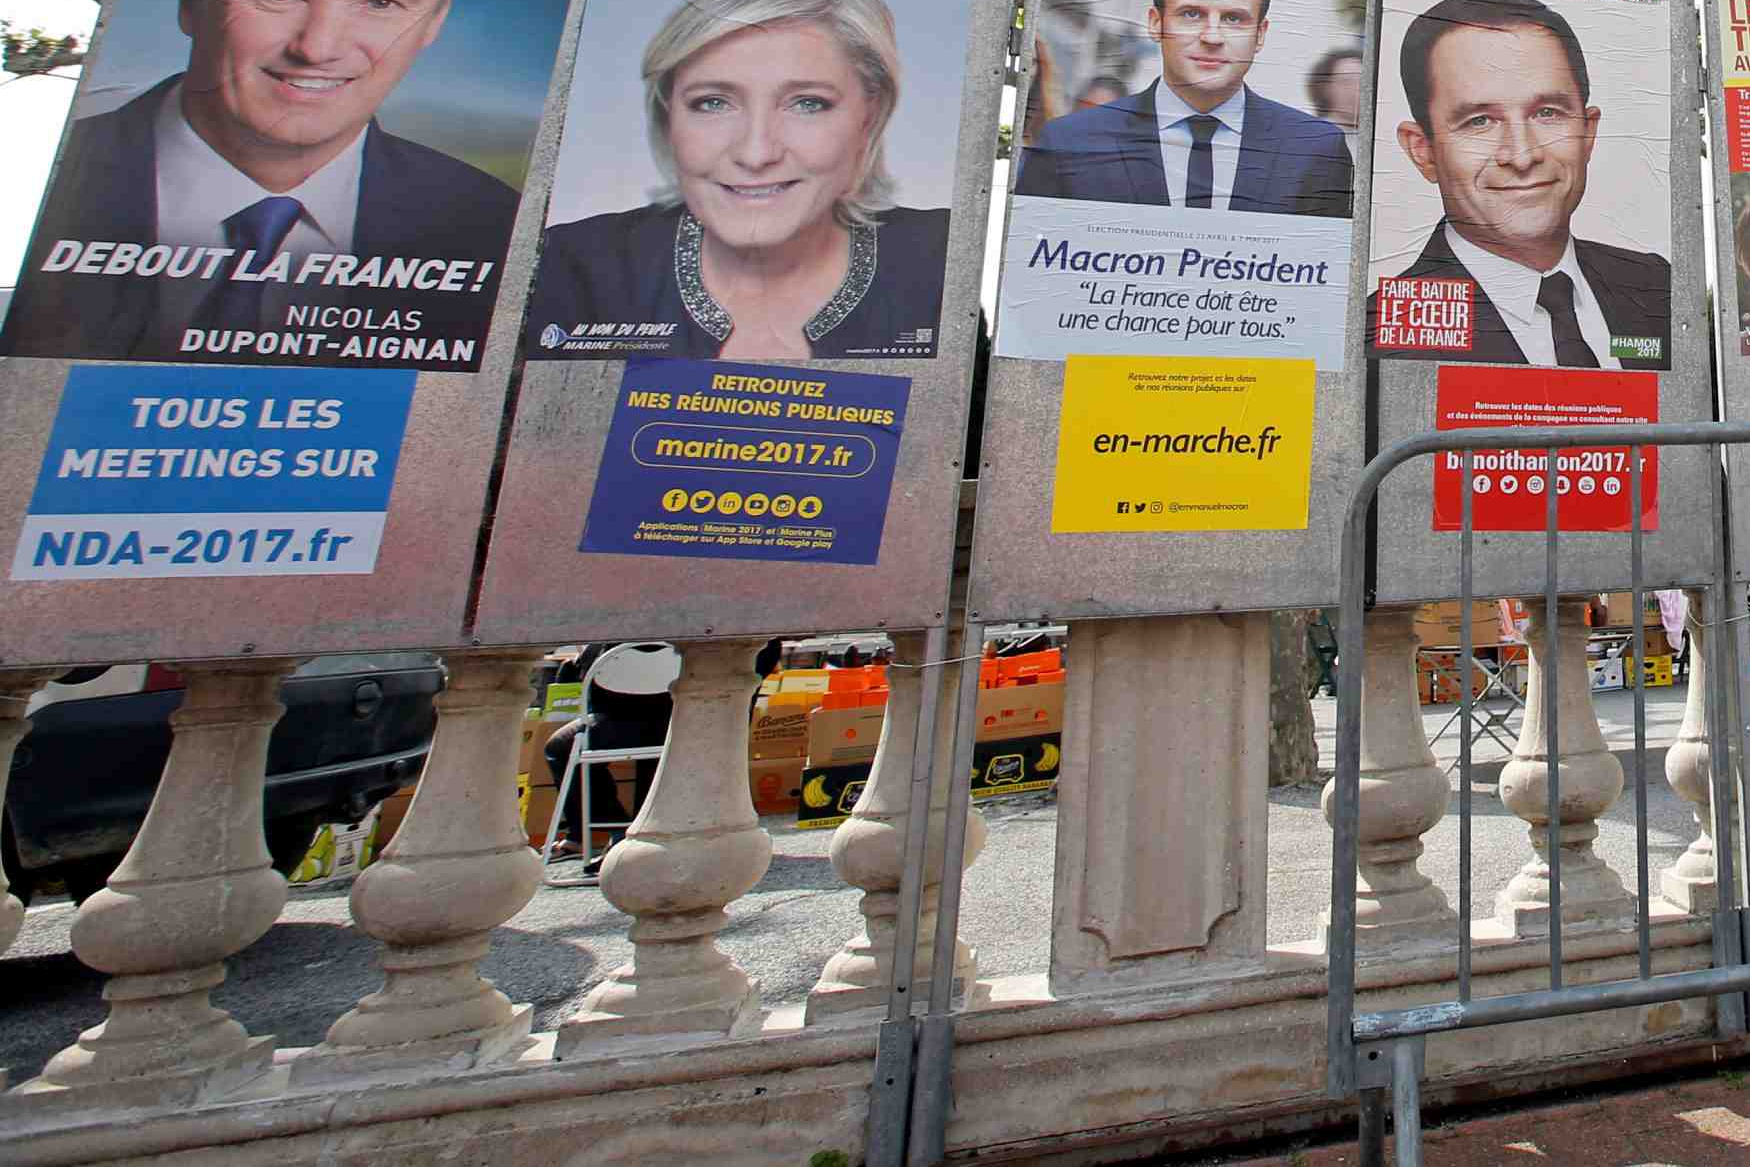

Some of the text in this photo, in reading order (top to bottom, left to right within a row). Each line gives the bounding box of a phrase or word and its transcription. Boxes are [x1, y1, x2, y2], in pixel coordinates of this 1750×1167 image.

[41, 240, 231, 279] DEBOUT
[231, 251, 293, 285] LA
[1028, 238, 1328, 284] Macron Président
[1121, 285, 1189, 308] France
[1196, 289, 1232, 311] doit
[1239, 291, 1278, 313] être
[1382, 280, 1470, 302] FAIRE BATTRE
[285, 305, 423, 332] NICOLAS
[1058, 314, 1099, 330] une
[1104, 309, 1179, 334] chance
[1185, 315, 1234, 340] pour
[1381, 300, 1404, 326] LE
[635, 323, 677, 336] PEUPLE
[1379, 327, 1469, 348] DE LA FRANCE
[180, 328, 475, 362] DUPONT-AIGNAN
[563, 340, 612, 350] MARINE
[1611, 337, 1661, 350] #HAMON
[1637, 347, 1661, 358] 2017
[712, 374, 826, 399] RETROUVEZ
[132, 398, 342, 429] TOUS LES
[628, 391, 895, 425] MES RÉUNIONS PUBLIQUES
[1455, 412, 1615, 424] des campagne consultant
[1475, 401, 1622, 414] Retrouvez les dates des publiques
[656, 436, 854, 468] marine2017.fr
[1093, 426, 1281, 460] en-marche.fr
[58, 448, 378, 479] MEETINGS SUR
[639, 521, 761, 535] Applications Marine 2017
[643, 531, 810, 549] télécharger App Store Google
[33, 528, 353, 568] NDA-2017.fr
